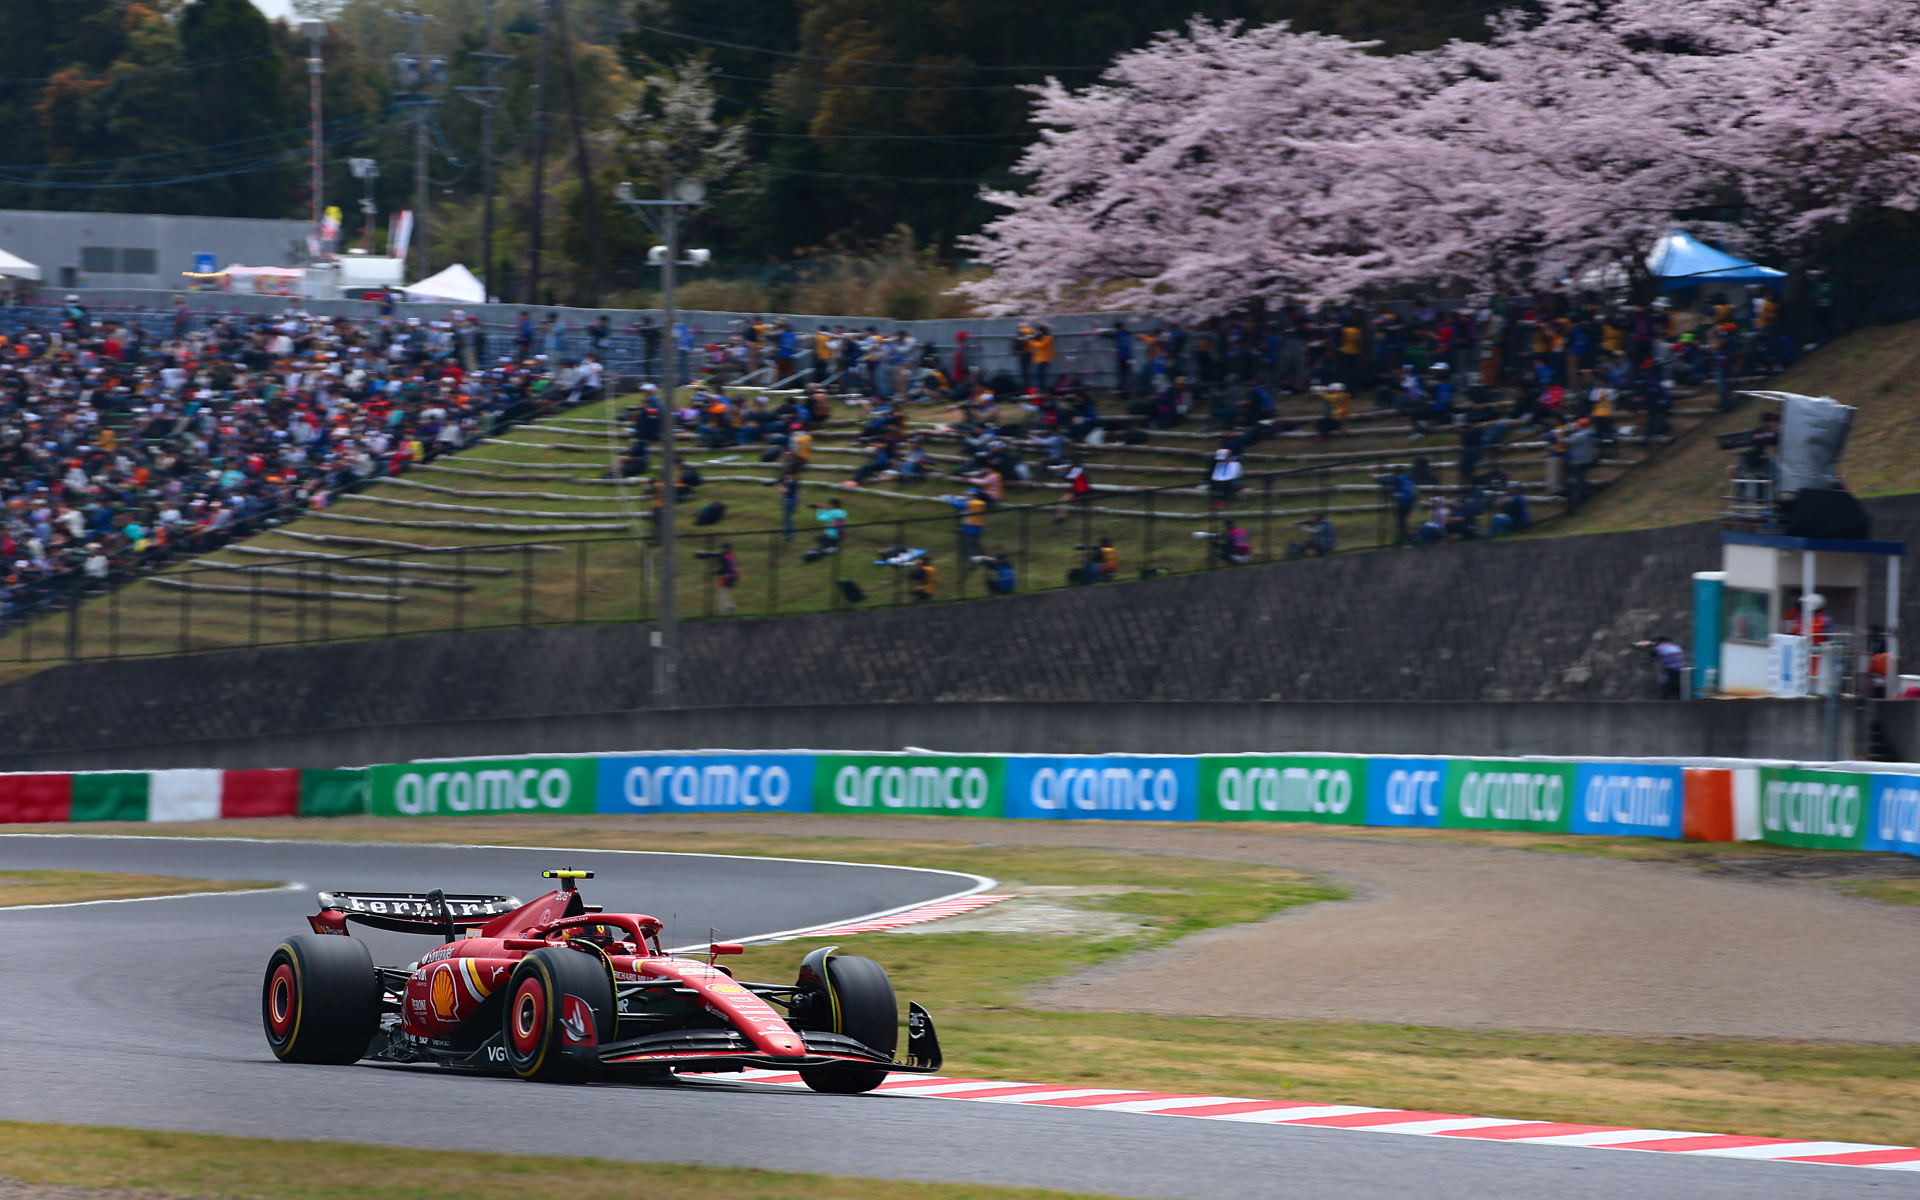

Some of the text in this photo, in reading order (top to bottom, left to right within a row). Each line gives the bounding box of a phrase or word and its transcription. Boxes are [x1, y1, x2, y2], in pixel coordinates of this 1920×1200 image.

[395, 768, 571, 815] aramco
[624, 765, 790, 807] aramco
[834, 765, 988, 809] aramco
[1031, 768, 1178, 811] aramco
[1218, 767, 1352, 814] aramco
[1459, 771, 1564, 822] aramco
[487, 1046, 507, 1062] VG
